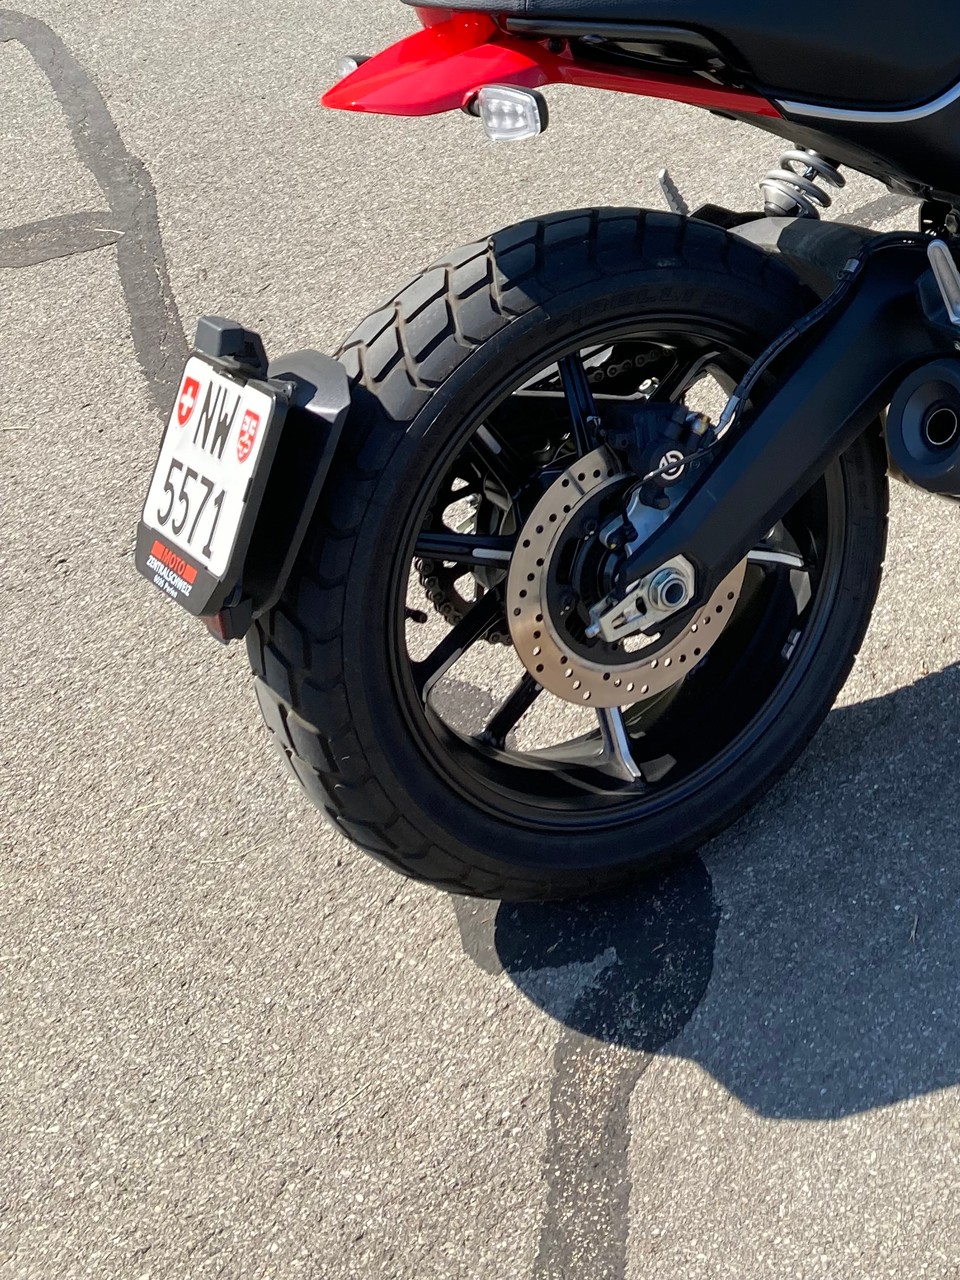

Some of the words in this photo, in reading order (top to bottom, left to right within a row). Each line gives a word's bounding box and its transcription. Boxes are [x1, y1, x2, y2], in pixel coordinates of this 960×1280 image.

[193, 380, 241, 460] NW
[156, 458, 228, 560] 5571
[146, 555, 192, 596] ZENTRALSCHWEIZ
[161, 547, 187, 576] MOTO
